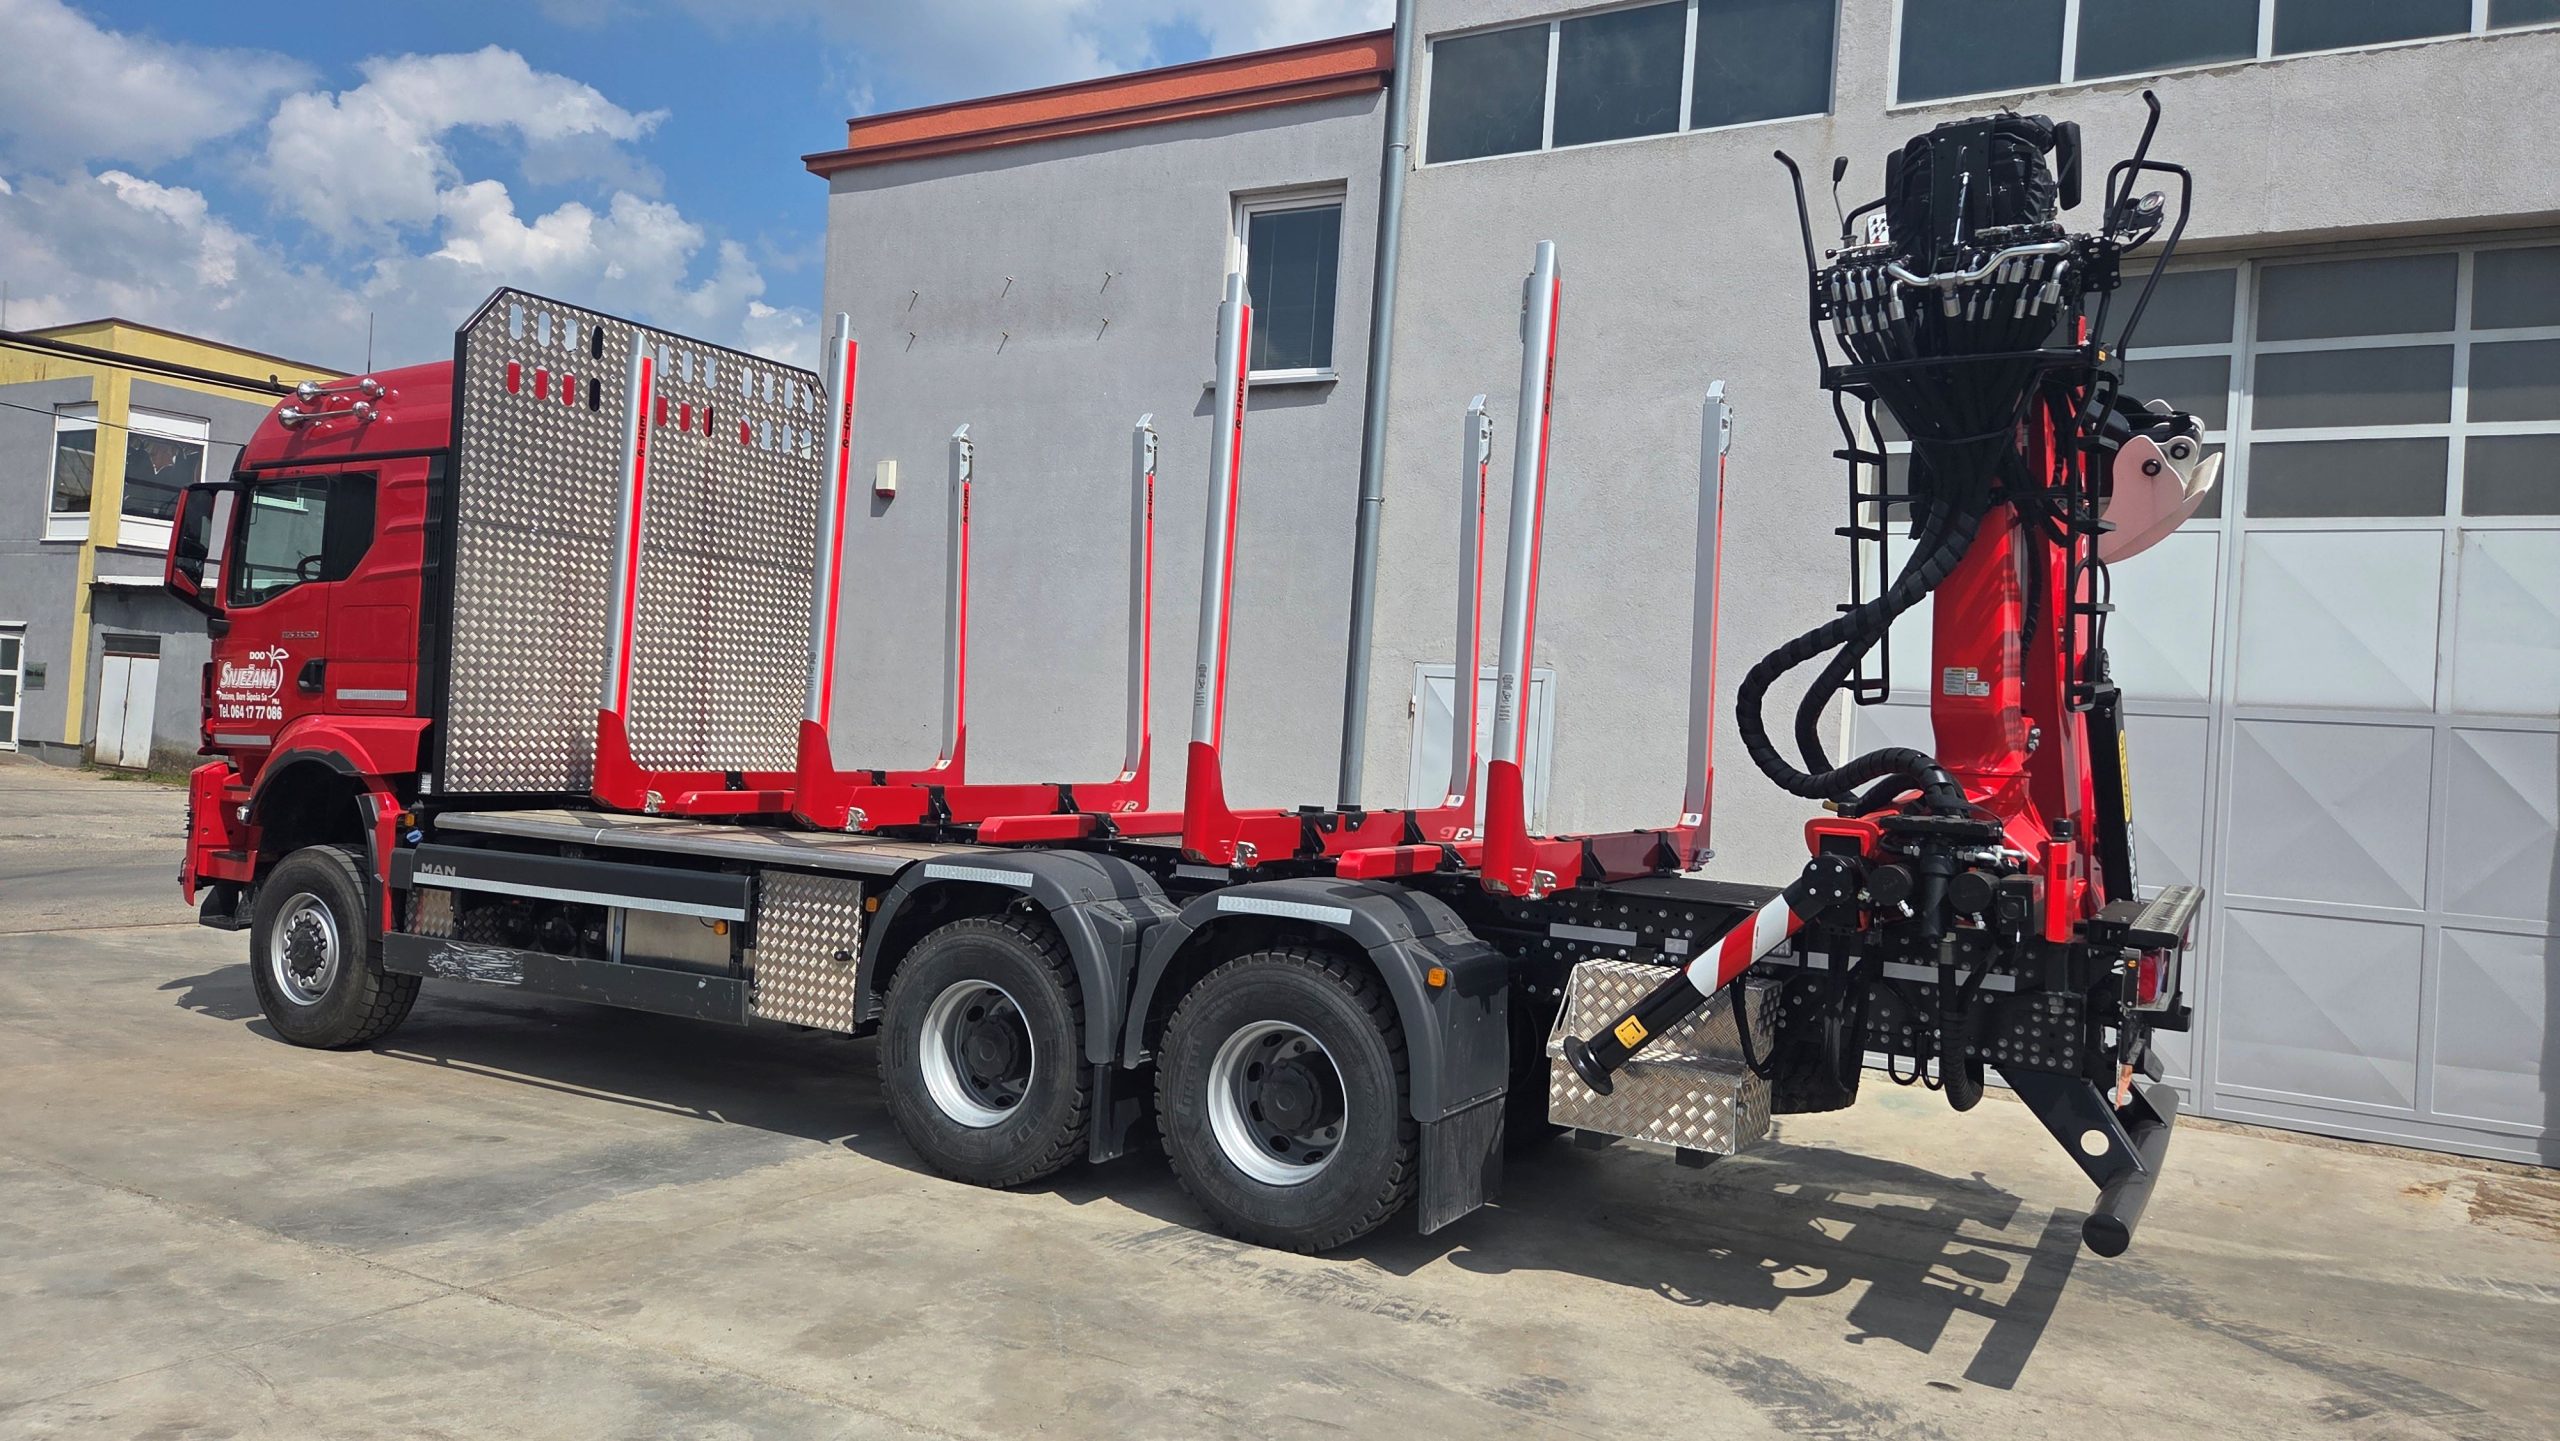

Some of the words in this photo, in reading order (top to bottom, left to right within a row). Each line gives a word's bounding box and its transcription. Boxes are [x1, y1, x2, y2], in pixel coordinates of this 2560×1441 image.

[249, 651, 265, 660] DOO
[220, 661, 277, 689] SNJEŽANA
[219, 703, 230, 718] Tel.
[230, 704, 245, 719] 064
[246, 705, 254, 719] 17
[255, 705, 265, 719] 77
[266, 706, 283, 720] 086
[421, 862, 456, 876] MAN
